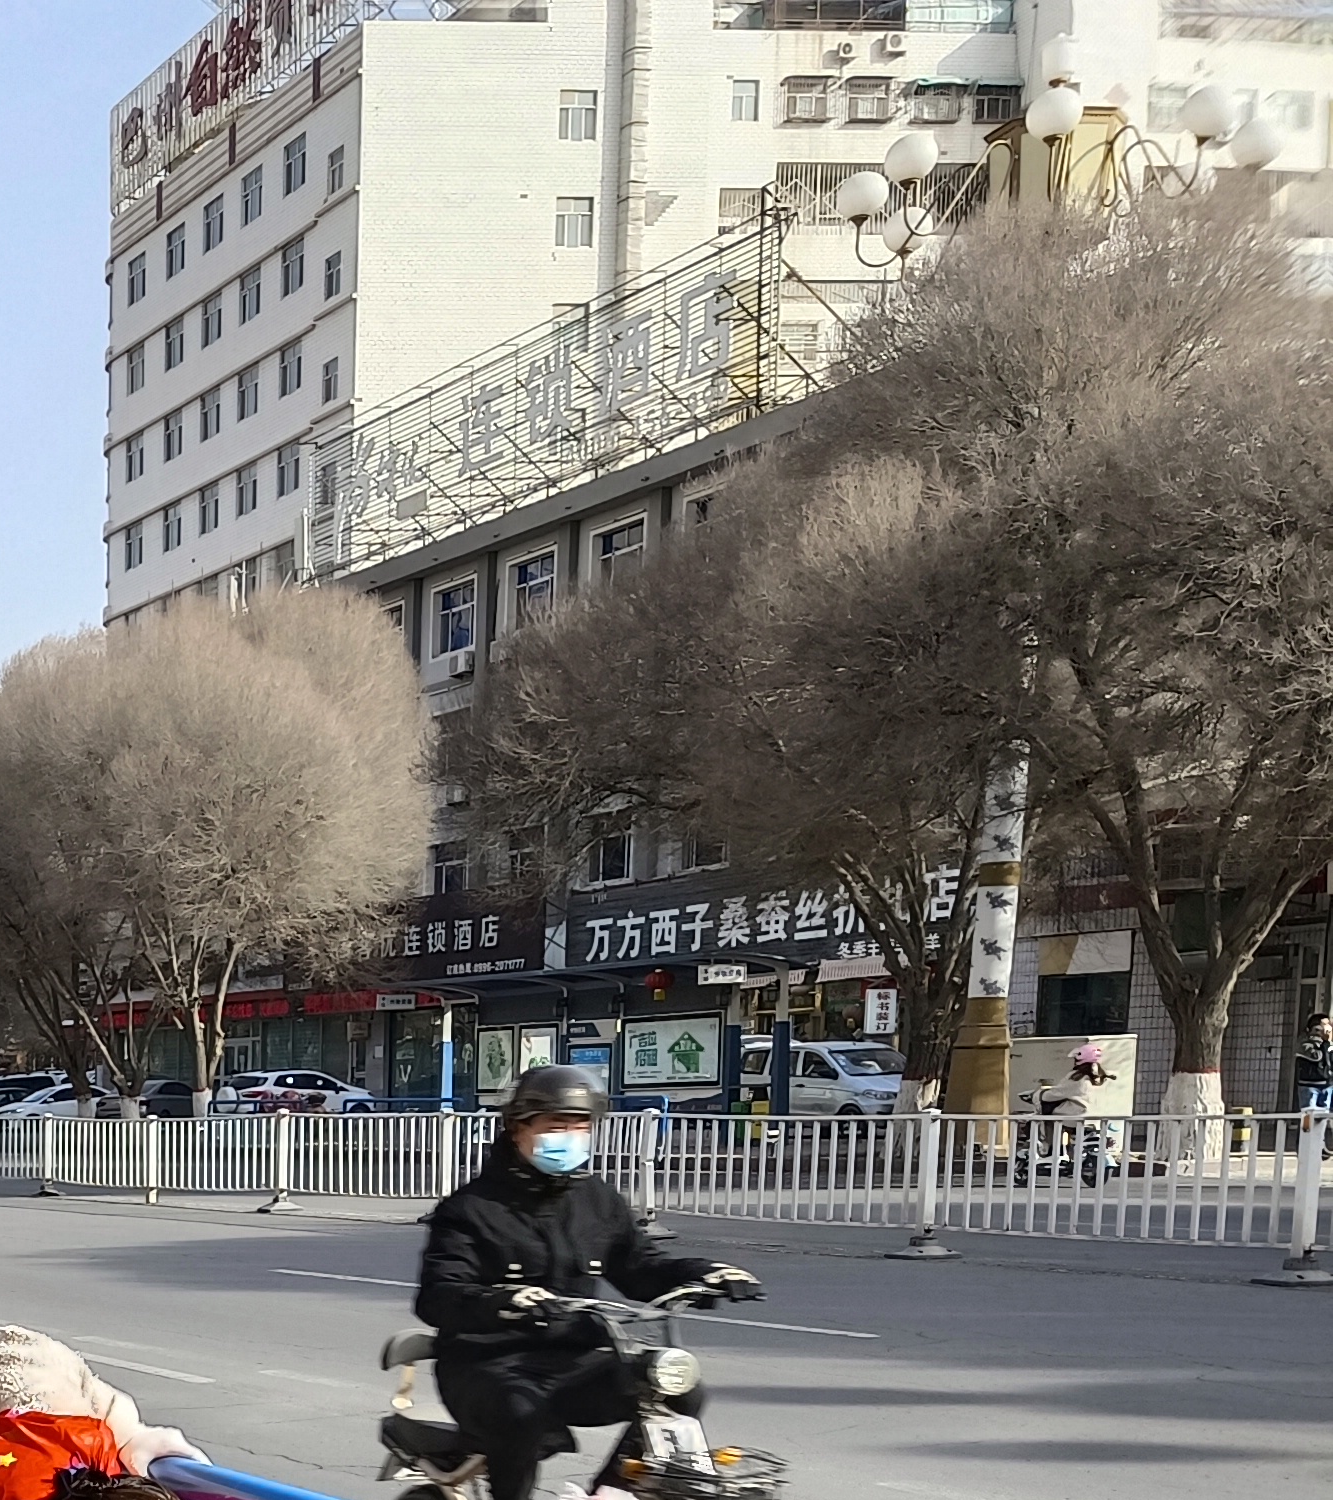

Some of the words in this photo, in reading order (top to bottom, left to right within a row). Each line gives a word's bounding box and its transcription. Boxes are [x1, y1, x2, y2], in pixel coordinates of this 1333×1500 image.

[584, 864, 962, 964] 万方西子桑蚕丝店
